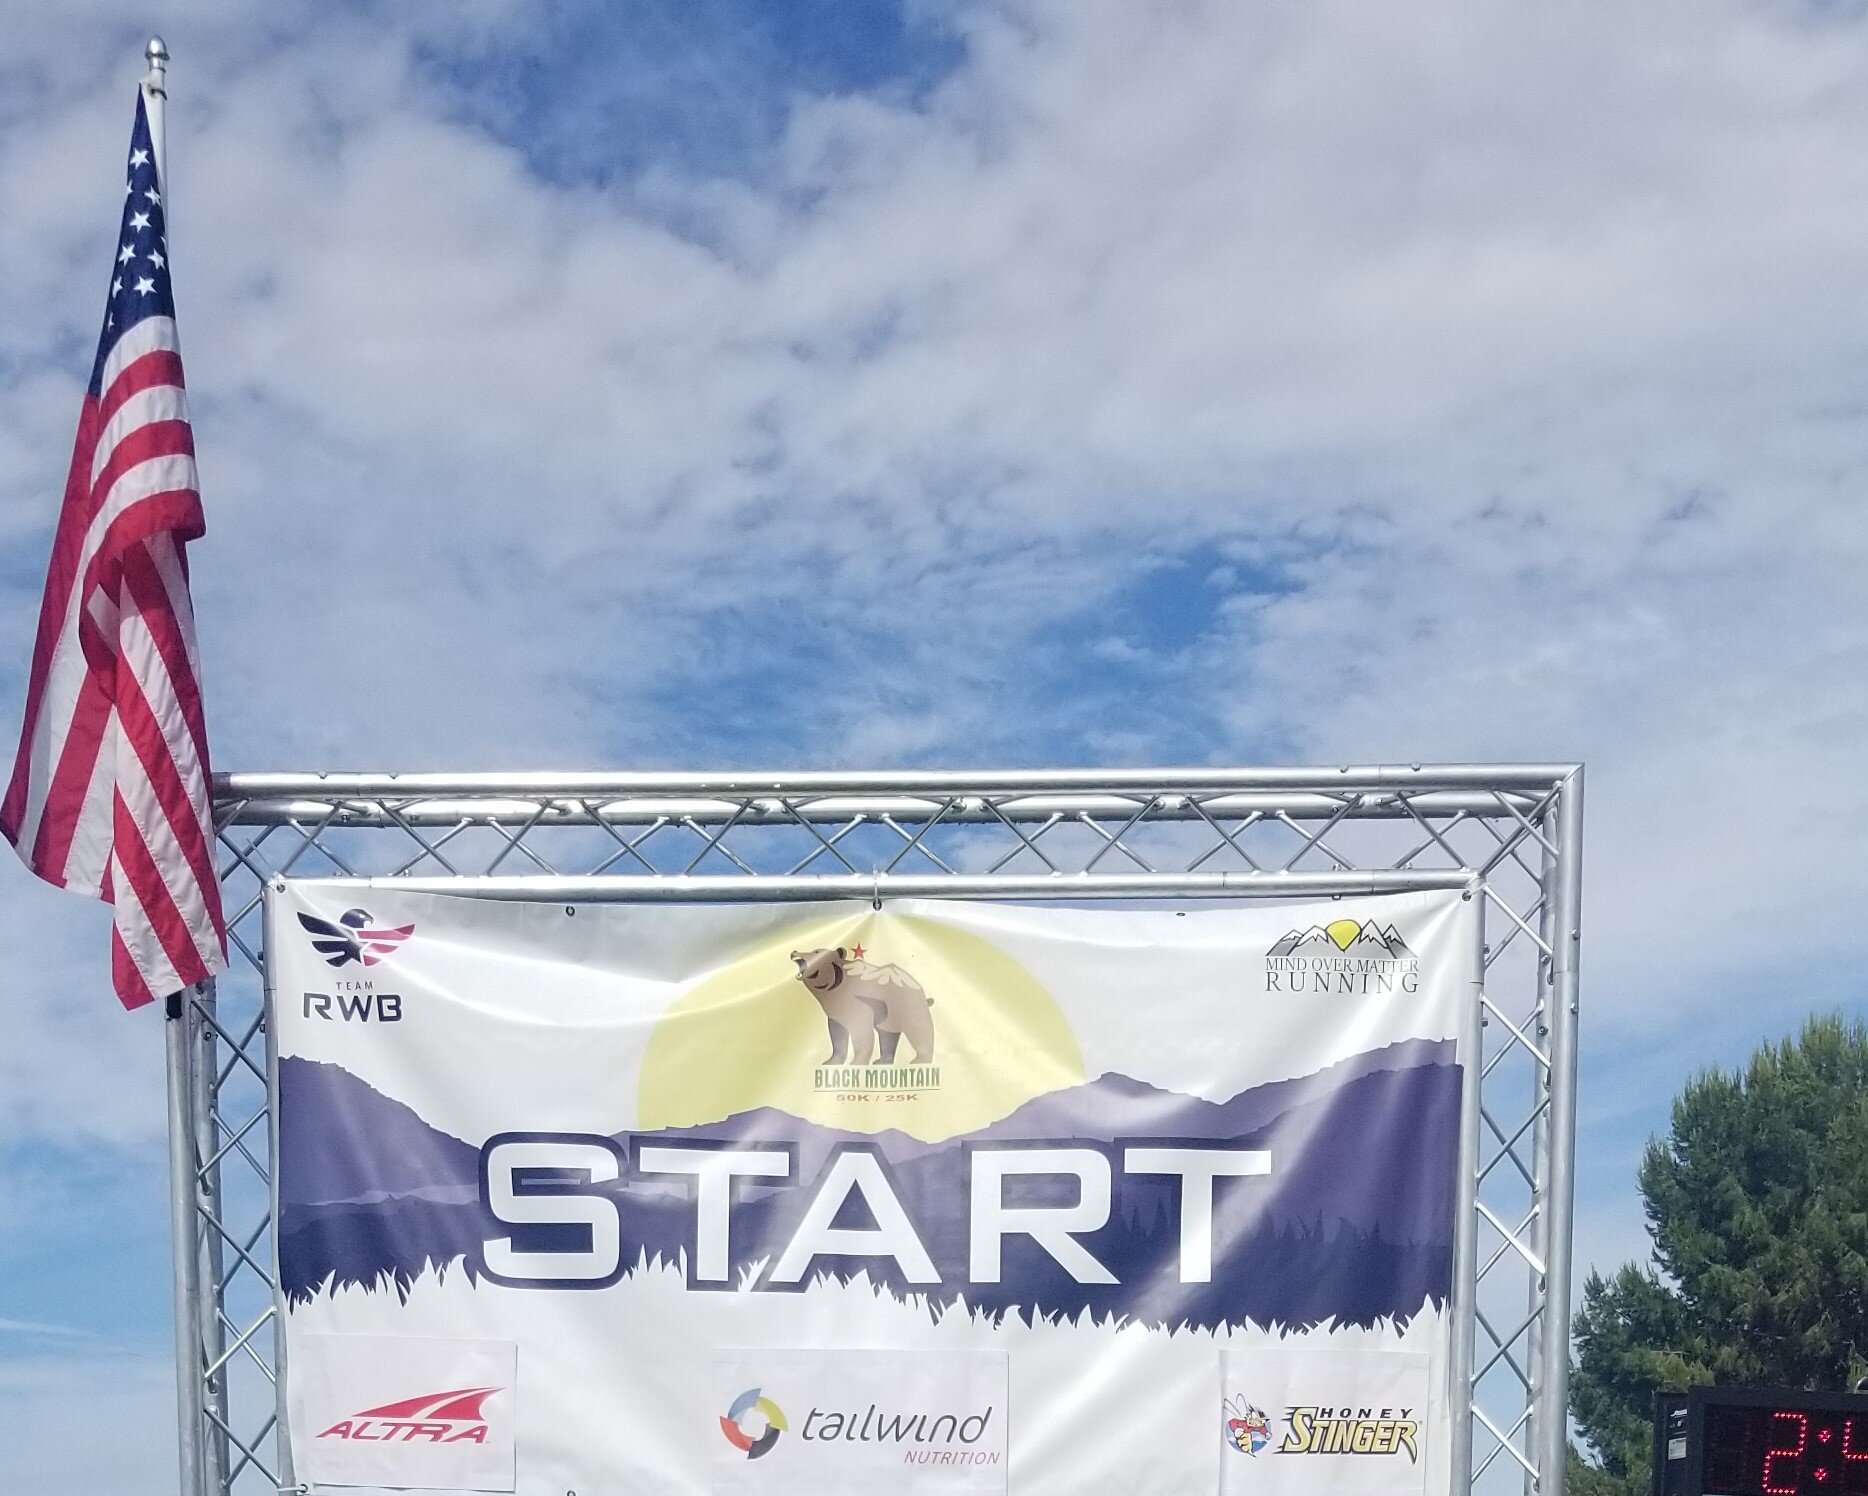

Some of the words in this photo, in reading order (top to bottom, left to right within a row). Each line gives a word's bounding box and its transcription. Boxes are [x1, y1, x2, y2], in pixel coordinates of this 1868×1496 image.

[1265, 957, 1307, 971] MIND
[1311, 958, 1353, 972] OVER
[1356, 959, 1420, 973] MATTER
[336, 981, 374, 991] TEAM
[1265, 972, 1419, 994] RUNNING
[303, 992, 403, 1022] RWB
[814, 1069, 860, 1088] BLACK
[865, 1067, 940, 1088] MOUNTAIN
[836, 1094, 870, 1102] 50K
[885, 1093, 919, 1102] 25K
[482, 1142, 1273, 1285] START
[1319, 1407, 1413, 1419] HONEY
[315, 1420, 489, 1444] ALTRA
[802, 1404, 992, 1444] tailwind
[1274, 1406, 1418, 1465] STINGER
[904, 1450, 1000, 1465] NUTRITION
